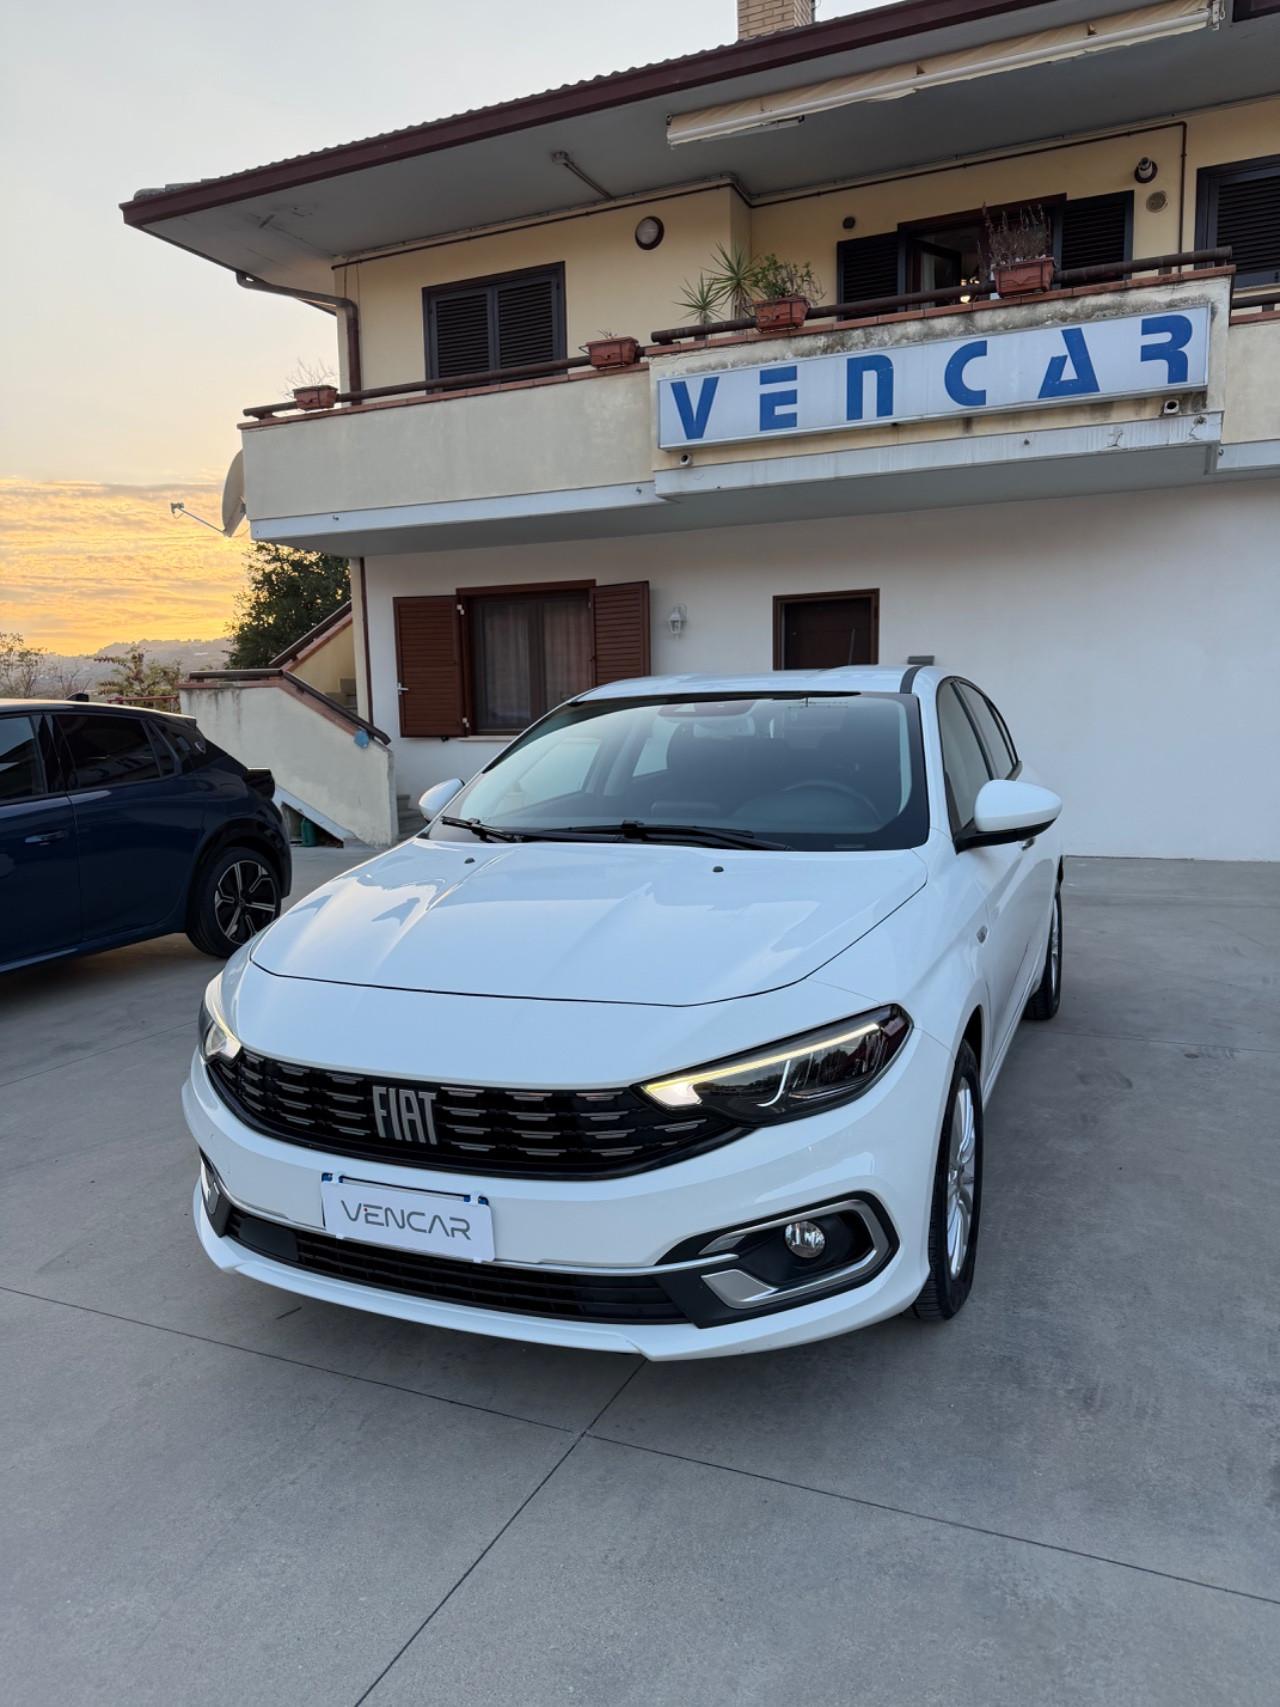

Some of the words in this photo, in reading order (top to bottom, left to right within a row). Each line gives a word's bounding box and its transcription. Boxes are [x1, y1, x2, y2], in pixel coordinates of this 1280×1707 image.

[671, 315, 1192, 440] VENCAR
[373, 1086, 437, 1145] FIAT
[341, 1200, 471, 1240] VENCAR
